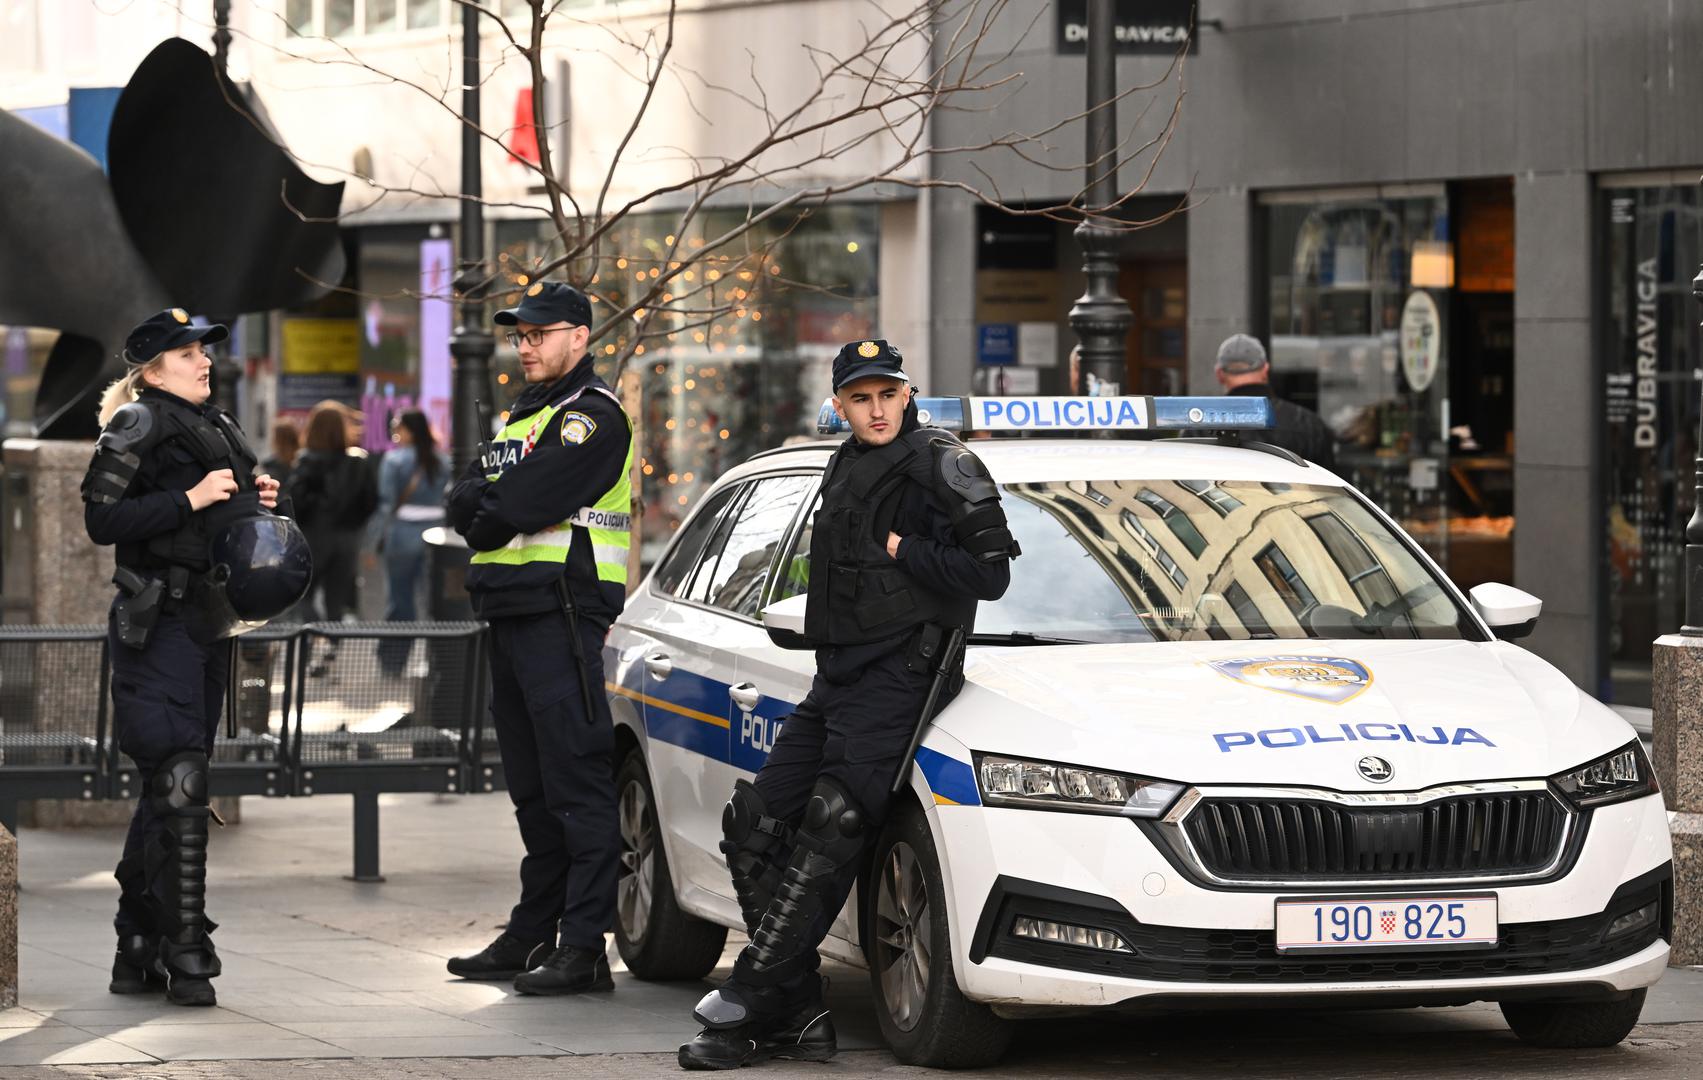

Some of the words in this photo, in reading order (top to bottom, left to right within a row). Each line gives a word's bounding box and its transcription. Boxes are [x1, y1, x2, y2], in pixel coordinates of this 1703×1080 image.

[1065, 23, 1188, 42] DRAVICA
[1636, 257, 1656, 447] DUBRAVICA
[982, 400, 1140, 427] POLICIJA
[1212, 723, 1497, 752] POLICIJA
[1314, 906, 1372, 942] 190
[1404, 903, 1466, 940] 825
